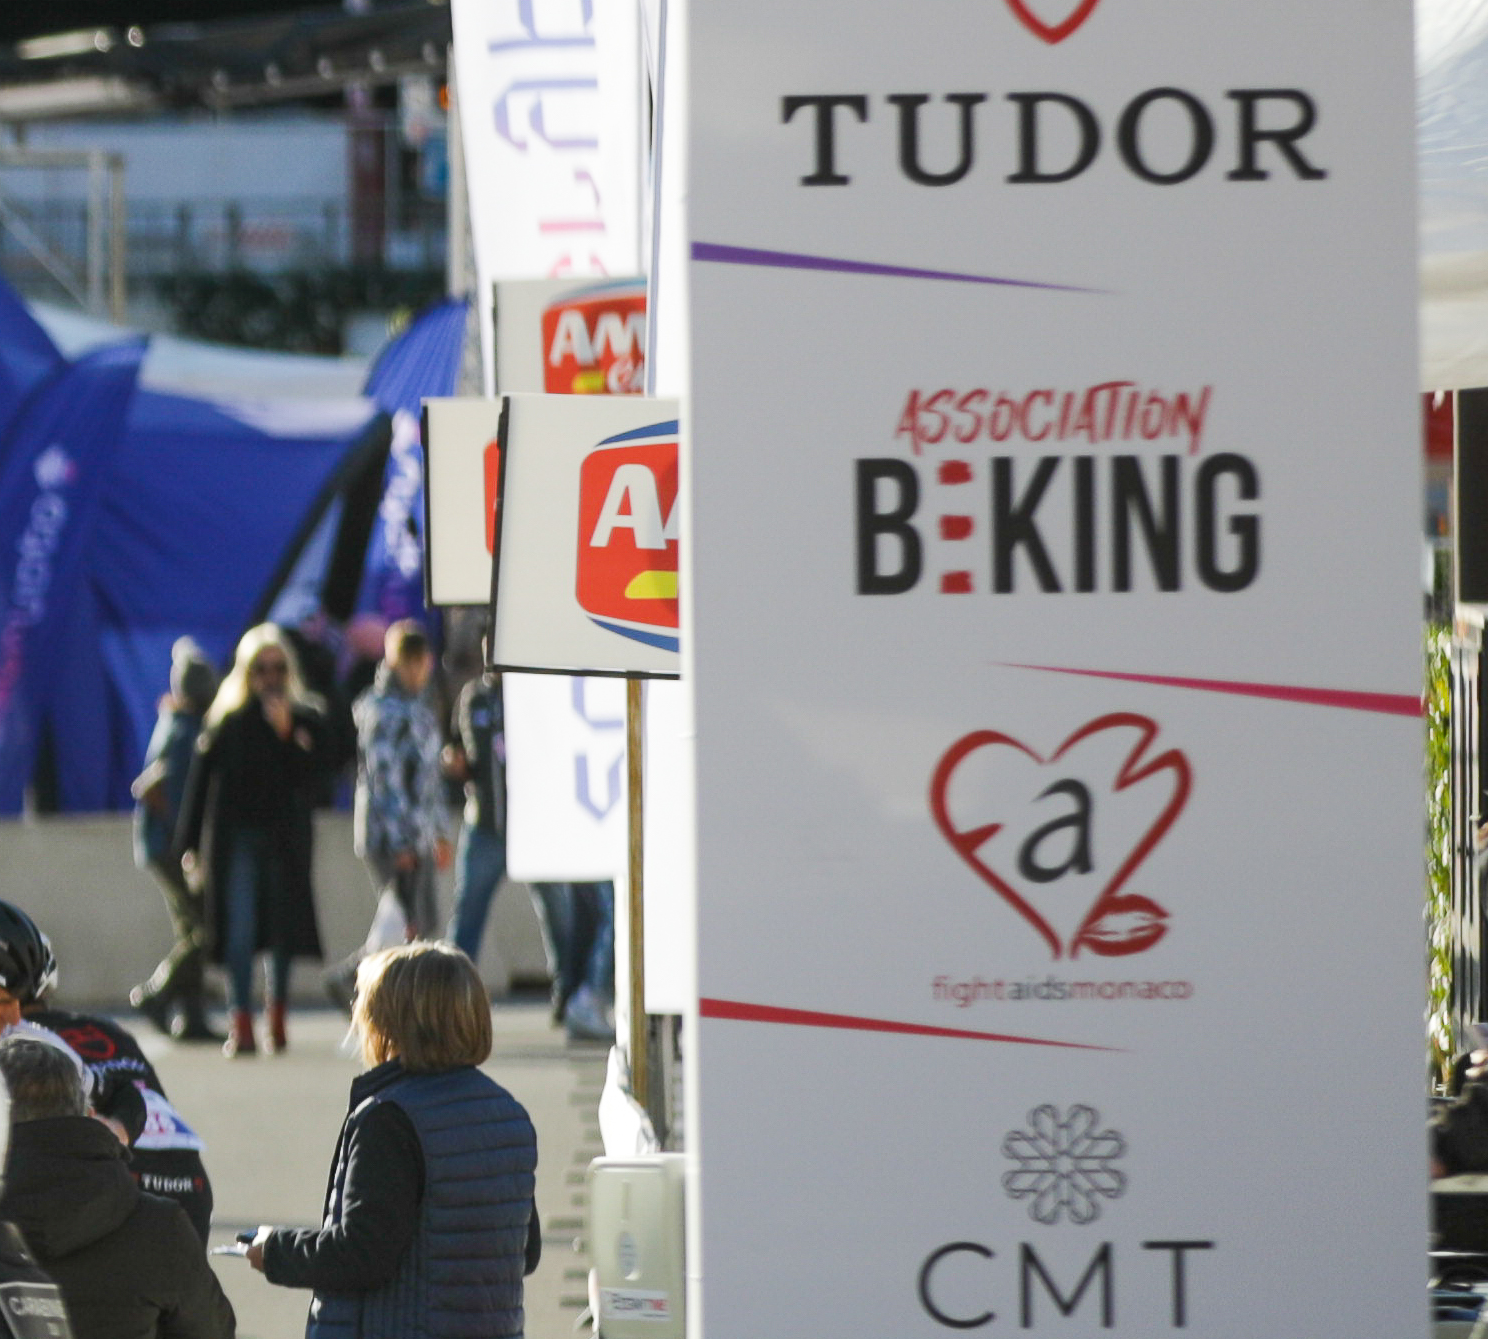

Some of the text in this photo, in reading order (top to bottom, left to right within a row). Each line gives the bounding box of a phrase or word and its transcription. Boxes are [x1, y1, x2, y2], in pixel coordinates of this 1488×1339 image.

[781, 86, 1329, 188] TUDOR
[894, 381, 1215, 457] ASSOCIATION
[590, 463, 678, 550] A
[931, 975, 1195, 1009] fightaidsmonaco
[917, 1239, 1216, 1331] CMT
